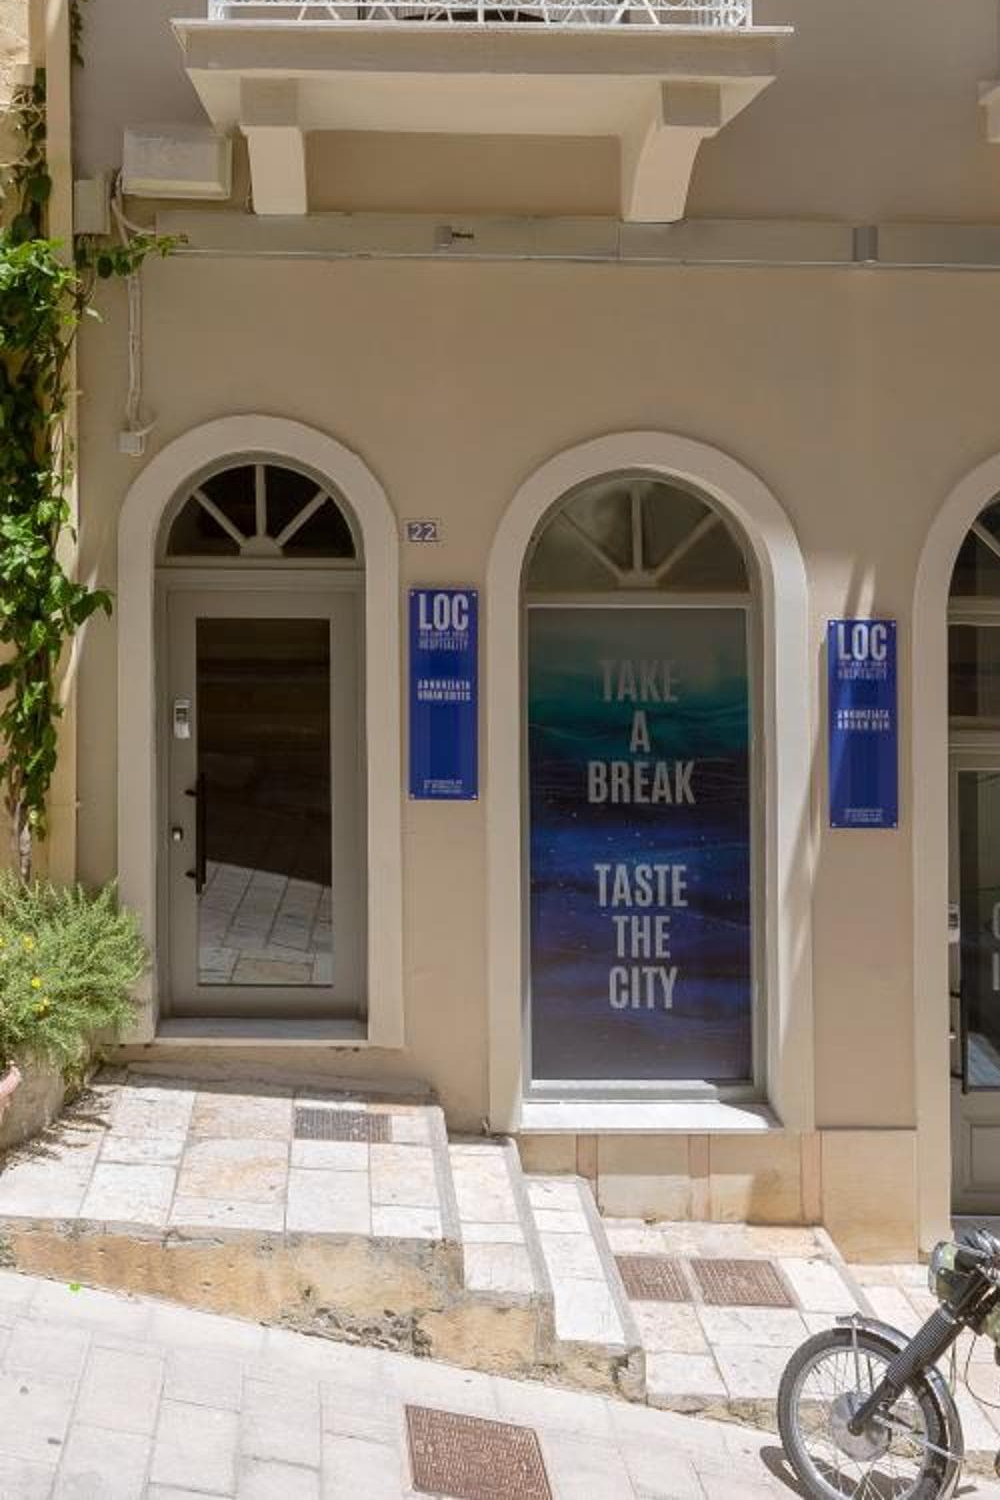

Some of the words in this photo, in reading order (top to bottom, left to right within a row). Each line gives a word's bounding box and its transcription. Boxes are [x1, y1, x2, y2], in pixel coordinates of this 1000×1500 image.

[411, 522, 435, 541] 22
[418, 593, 469, 631] LOC
[837, 623, 887, 661] LOC
[600, 659, 678, 701] TAKE
[628, 710, 651, 753] A
[588, 761, 696, 804] BREAK
[594, 864, 688, 907] TASTE
[612, 915, 671, 958] THE
[608, 966, 678, 1009] CITY
